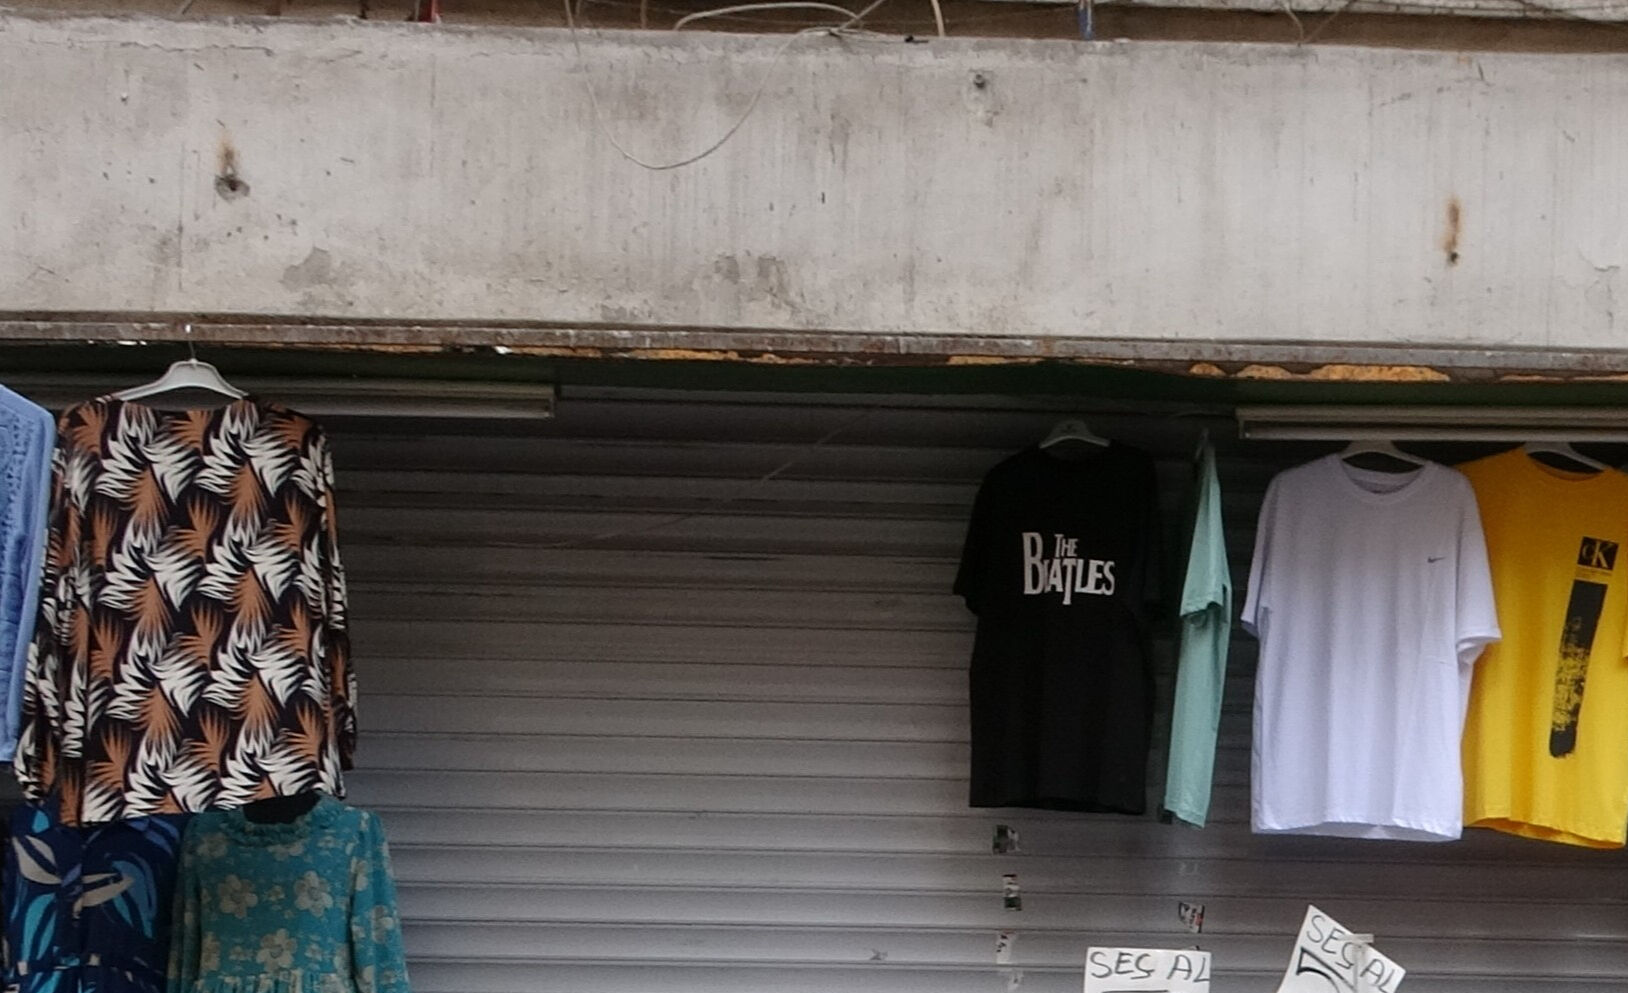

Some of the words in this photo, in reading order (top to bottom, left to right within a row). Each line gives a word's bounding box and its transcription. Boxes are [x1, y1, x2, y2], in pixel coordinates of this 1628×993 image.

[1054, 533, 1079, 558] THE
[1089, 951, 1155, 980] SEÇ
[1166, 954, 1211, 983] AL
